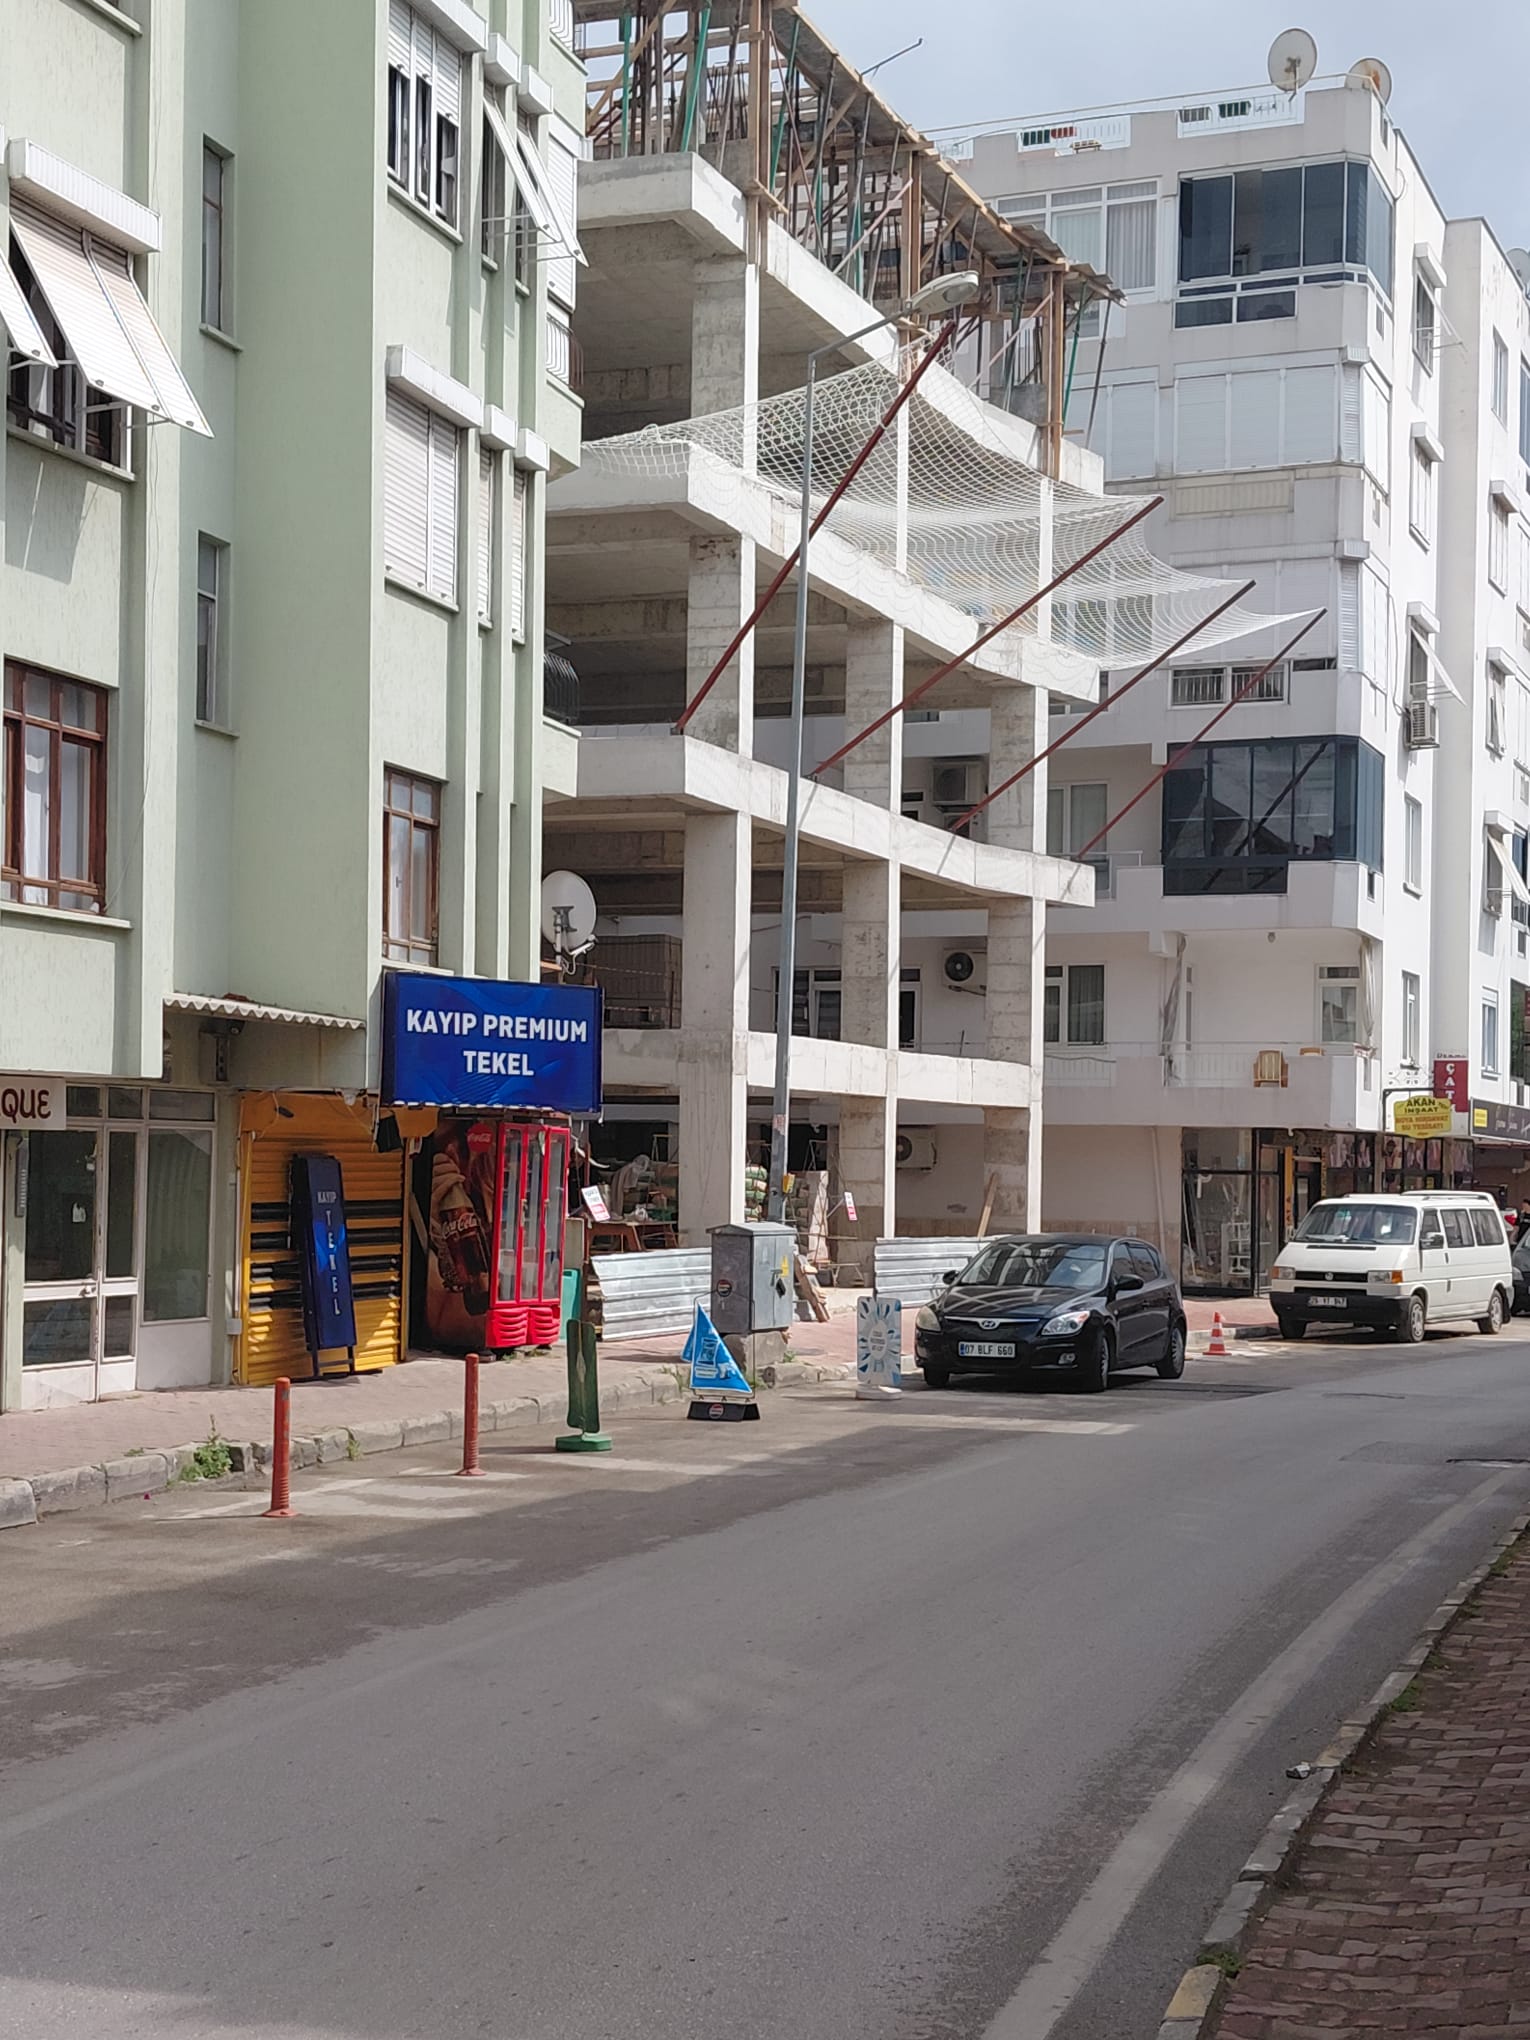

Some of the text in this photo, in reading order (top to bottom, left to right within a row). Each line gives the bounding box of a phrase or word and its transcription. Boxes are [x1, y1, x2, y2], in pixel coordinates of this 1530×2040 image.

[406, 1008, 587, 1042] KAYIP PREMIUM
[463, 1050, 535, 1076] TEKEL
[0, 1088, 51, 1124] QUE
[1406, 1097, 1436, 1107] AKAN
[317, 1191, 337, 1203] KAYIP
